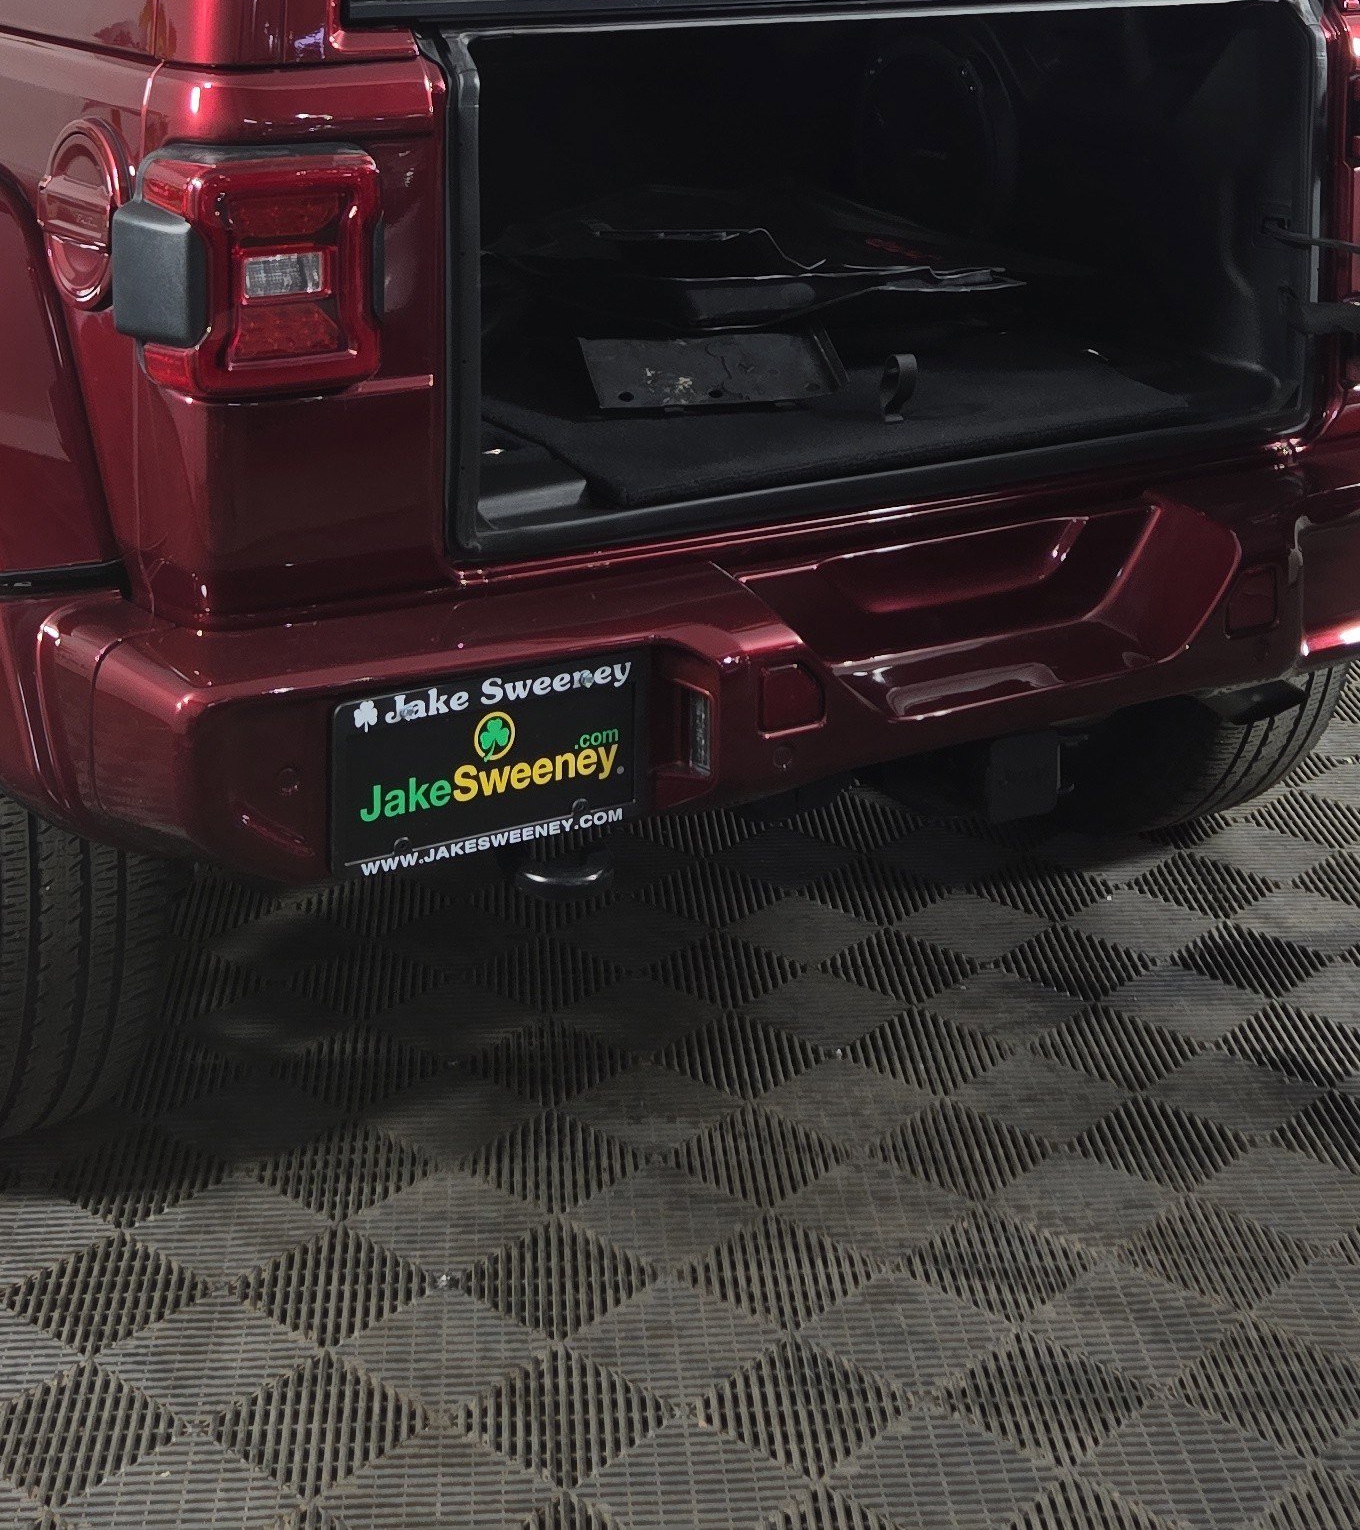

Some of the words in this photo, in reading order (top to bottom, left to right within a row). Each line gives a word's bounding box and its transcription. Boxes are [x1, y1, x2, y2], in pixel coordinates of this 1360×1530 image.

[385, 687, 470, 724] Jake
[480, 661, 632, 705] Sweeney
[573, 727, 619, 750] .com
[359, 743, 619, 822] JakeSweeney
[360, 807, 624, 877] WWW.JAKESWEENEY.COM
